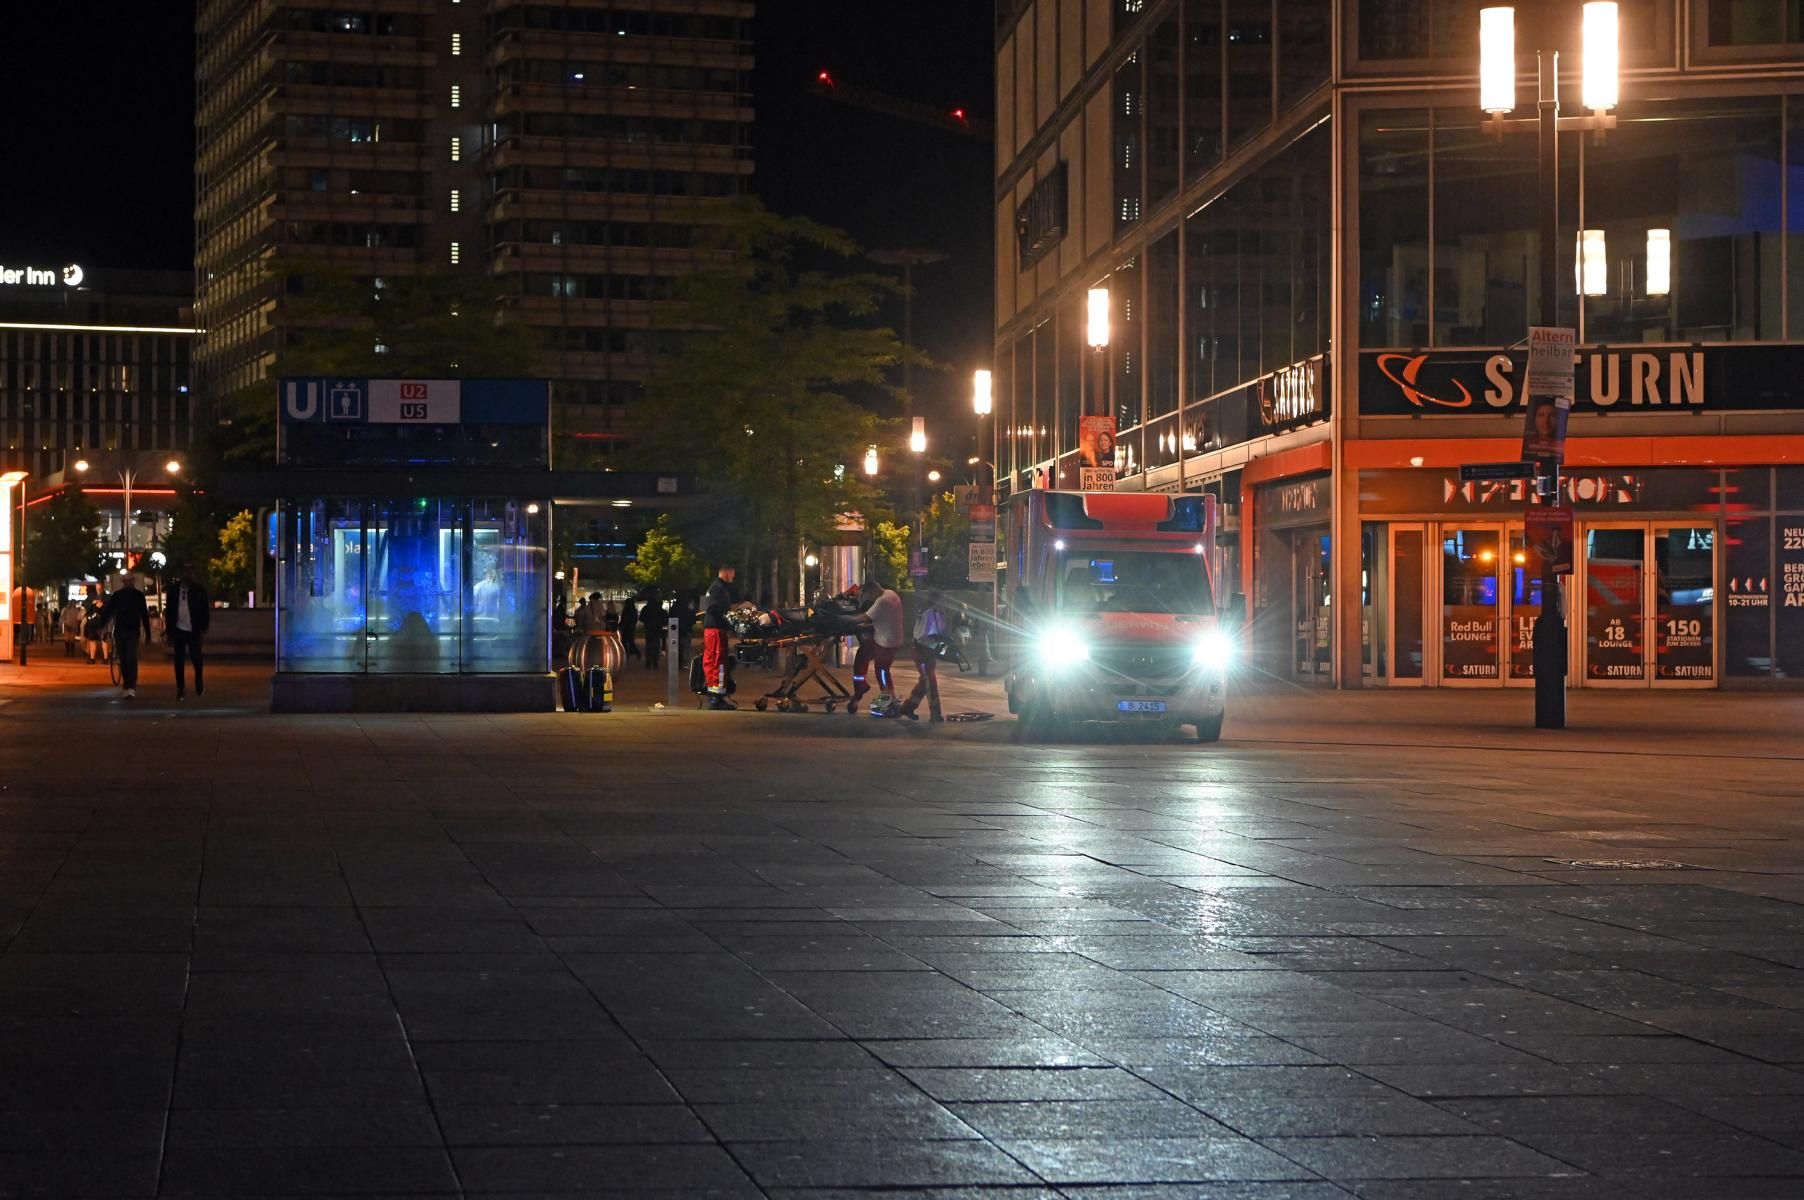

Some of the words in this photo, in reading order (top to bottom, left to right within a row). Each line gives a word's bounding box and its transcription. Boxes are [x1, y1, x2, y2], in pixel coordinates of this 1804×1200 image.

[27, 266, 56, 285] Inn
[1532, 330, 1573, 343] Altern
[1531, 343, 1572, 357] heilbar
[1484, 352, 1705, 407] SURN
[403, 385, 425, 398] U2
[286, 381, 318, 420] U
[403, 405, 425, 418] U5
[1083, 472, 1093, 482] in
[1096, 473, 1114, 482] 800
[1082, 482, 1114, 491] Jahren
[1451, 621, 1471, 631] Red
[1473, 621, 1492, 631] Bull
[1667, 620, 1701, 635] 150
[1451, 633, 1492, 641] LOUNGE
[1605, 627, 1625, 640] 18
[1463, 664, 1497, 675] SATURN
[1607, 665, 1642, 676] SATURN
[1675, 665, 1712, 676] SATURN
